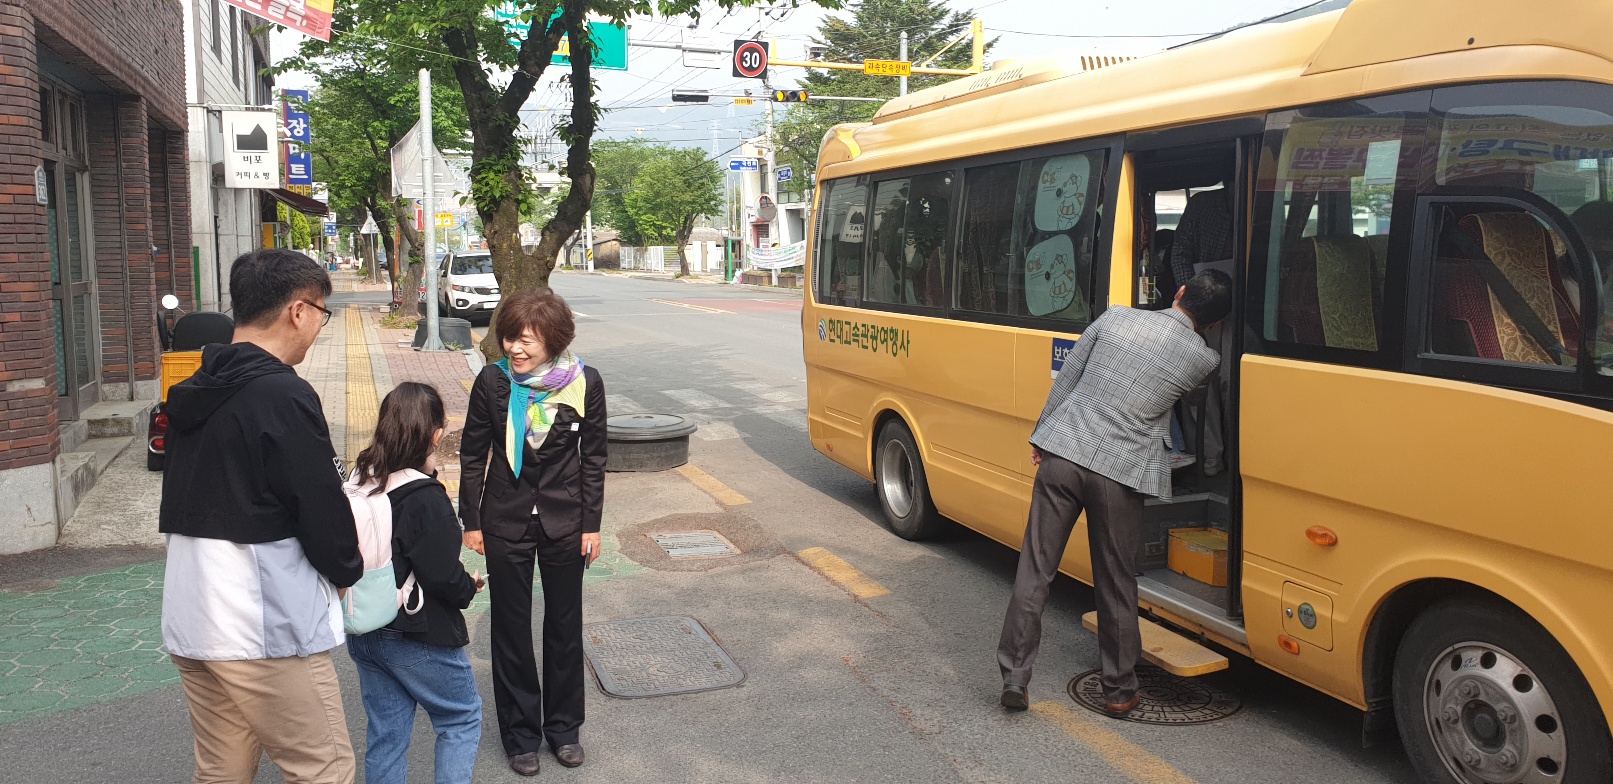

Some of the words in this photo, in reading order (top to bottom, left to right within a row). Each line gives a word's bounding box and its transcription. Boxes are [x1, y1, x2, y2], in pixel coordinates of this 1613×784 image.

[742, 51, 760, 68] 30
[868, 62, 908, 74] 과속단속장비
[242, 155, 263, 165] 비포
[253, 171, 260, 179] &
[262, 171, 270, 180] 빵
[828, 317, 910, 358] 현대고속관광여행사
